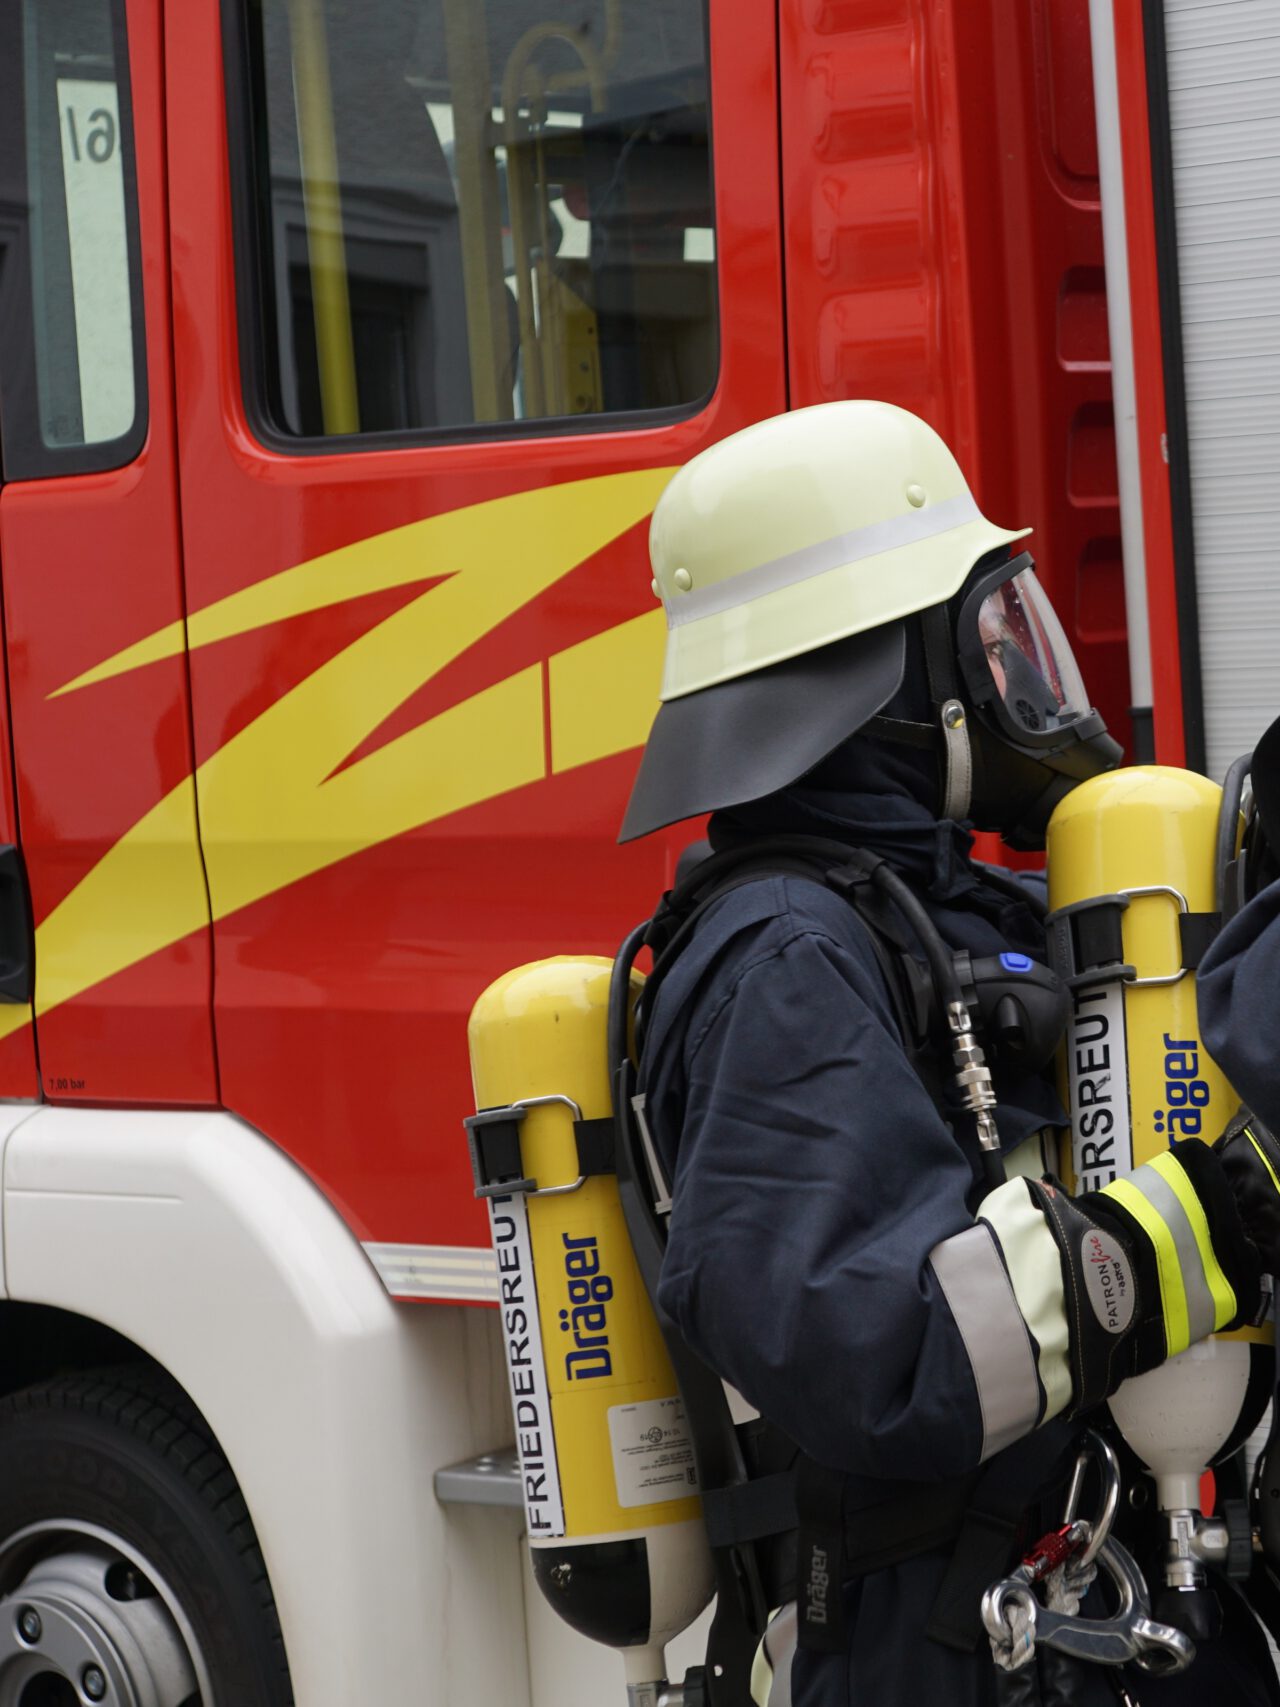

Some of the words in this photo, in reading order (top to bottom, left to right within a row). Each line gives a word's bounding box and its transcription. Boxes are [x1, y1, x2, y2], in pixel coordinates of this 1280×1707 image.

[70, 1078, 86, 1089] bar
[559, 1232, 614, 1381] Dräger
[806, 1545, 829, 1624] Dräger
